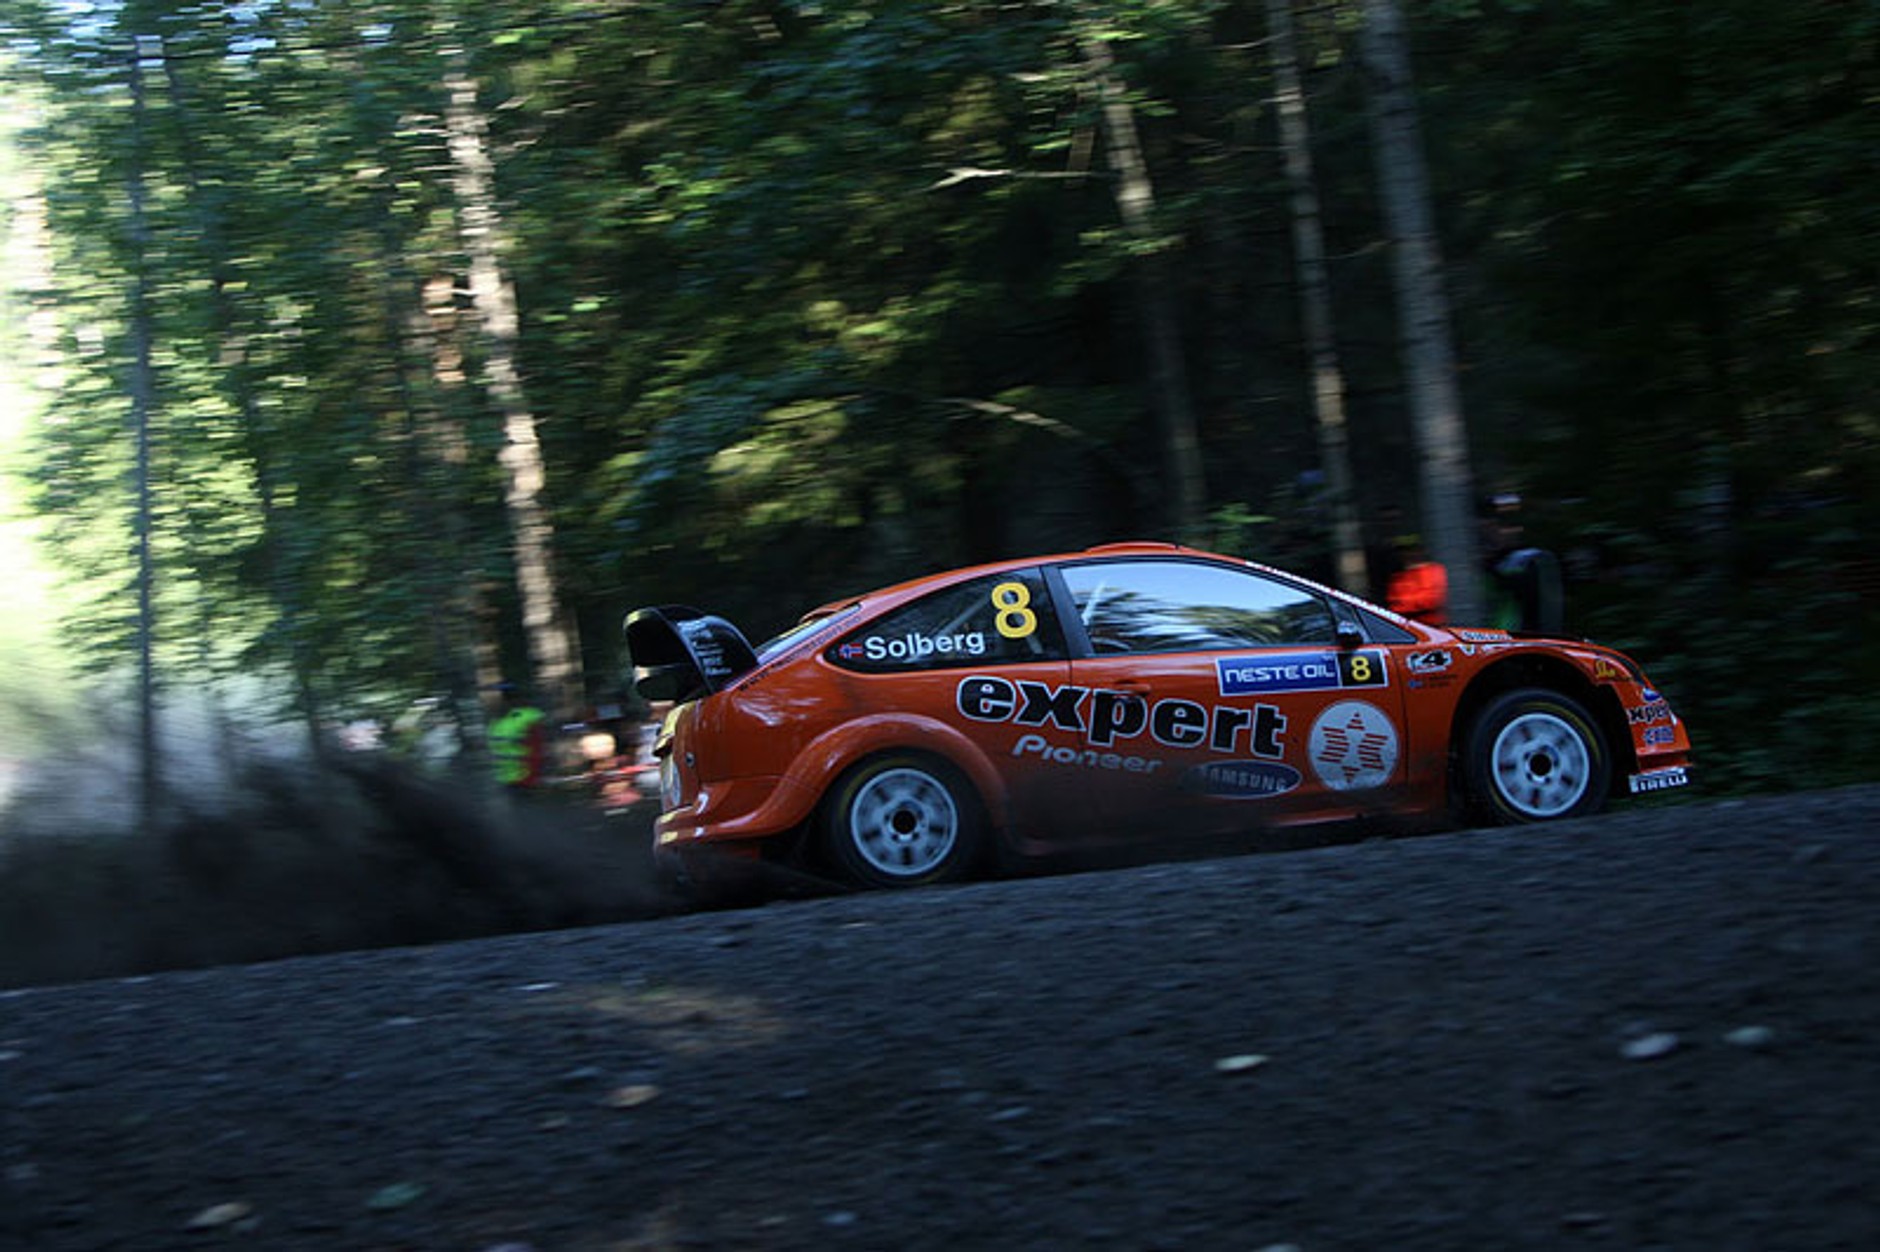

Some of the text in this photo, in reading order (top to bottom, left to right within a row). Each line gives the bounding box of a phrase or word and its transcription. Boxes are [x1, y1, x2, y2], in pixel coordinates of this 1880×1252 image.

[991, 582, 1037, 638] 8
[864, 632, 985, 660] Solberg
[1303, 663, 1335, 678] OIL
[1351, 656, 1371, 681] 8
[956, 675, 1287, 759] expert
[1012, 734, 1163, 774] Pioneer
[1201, 766, 1288, 794] AMSUNG
